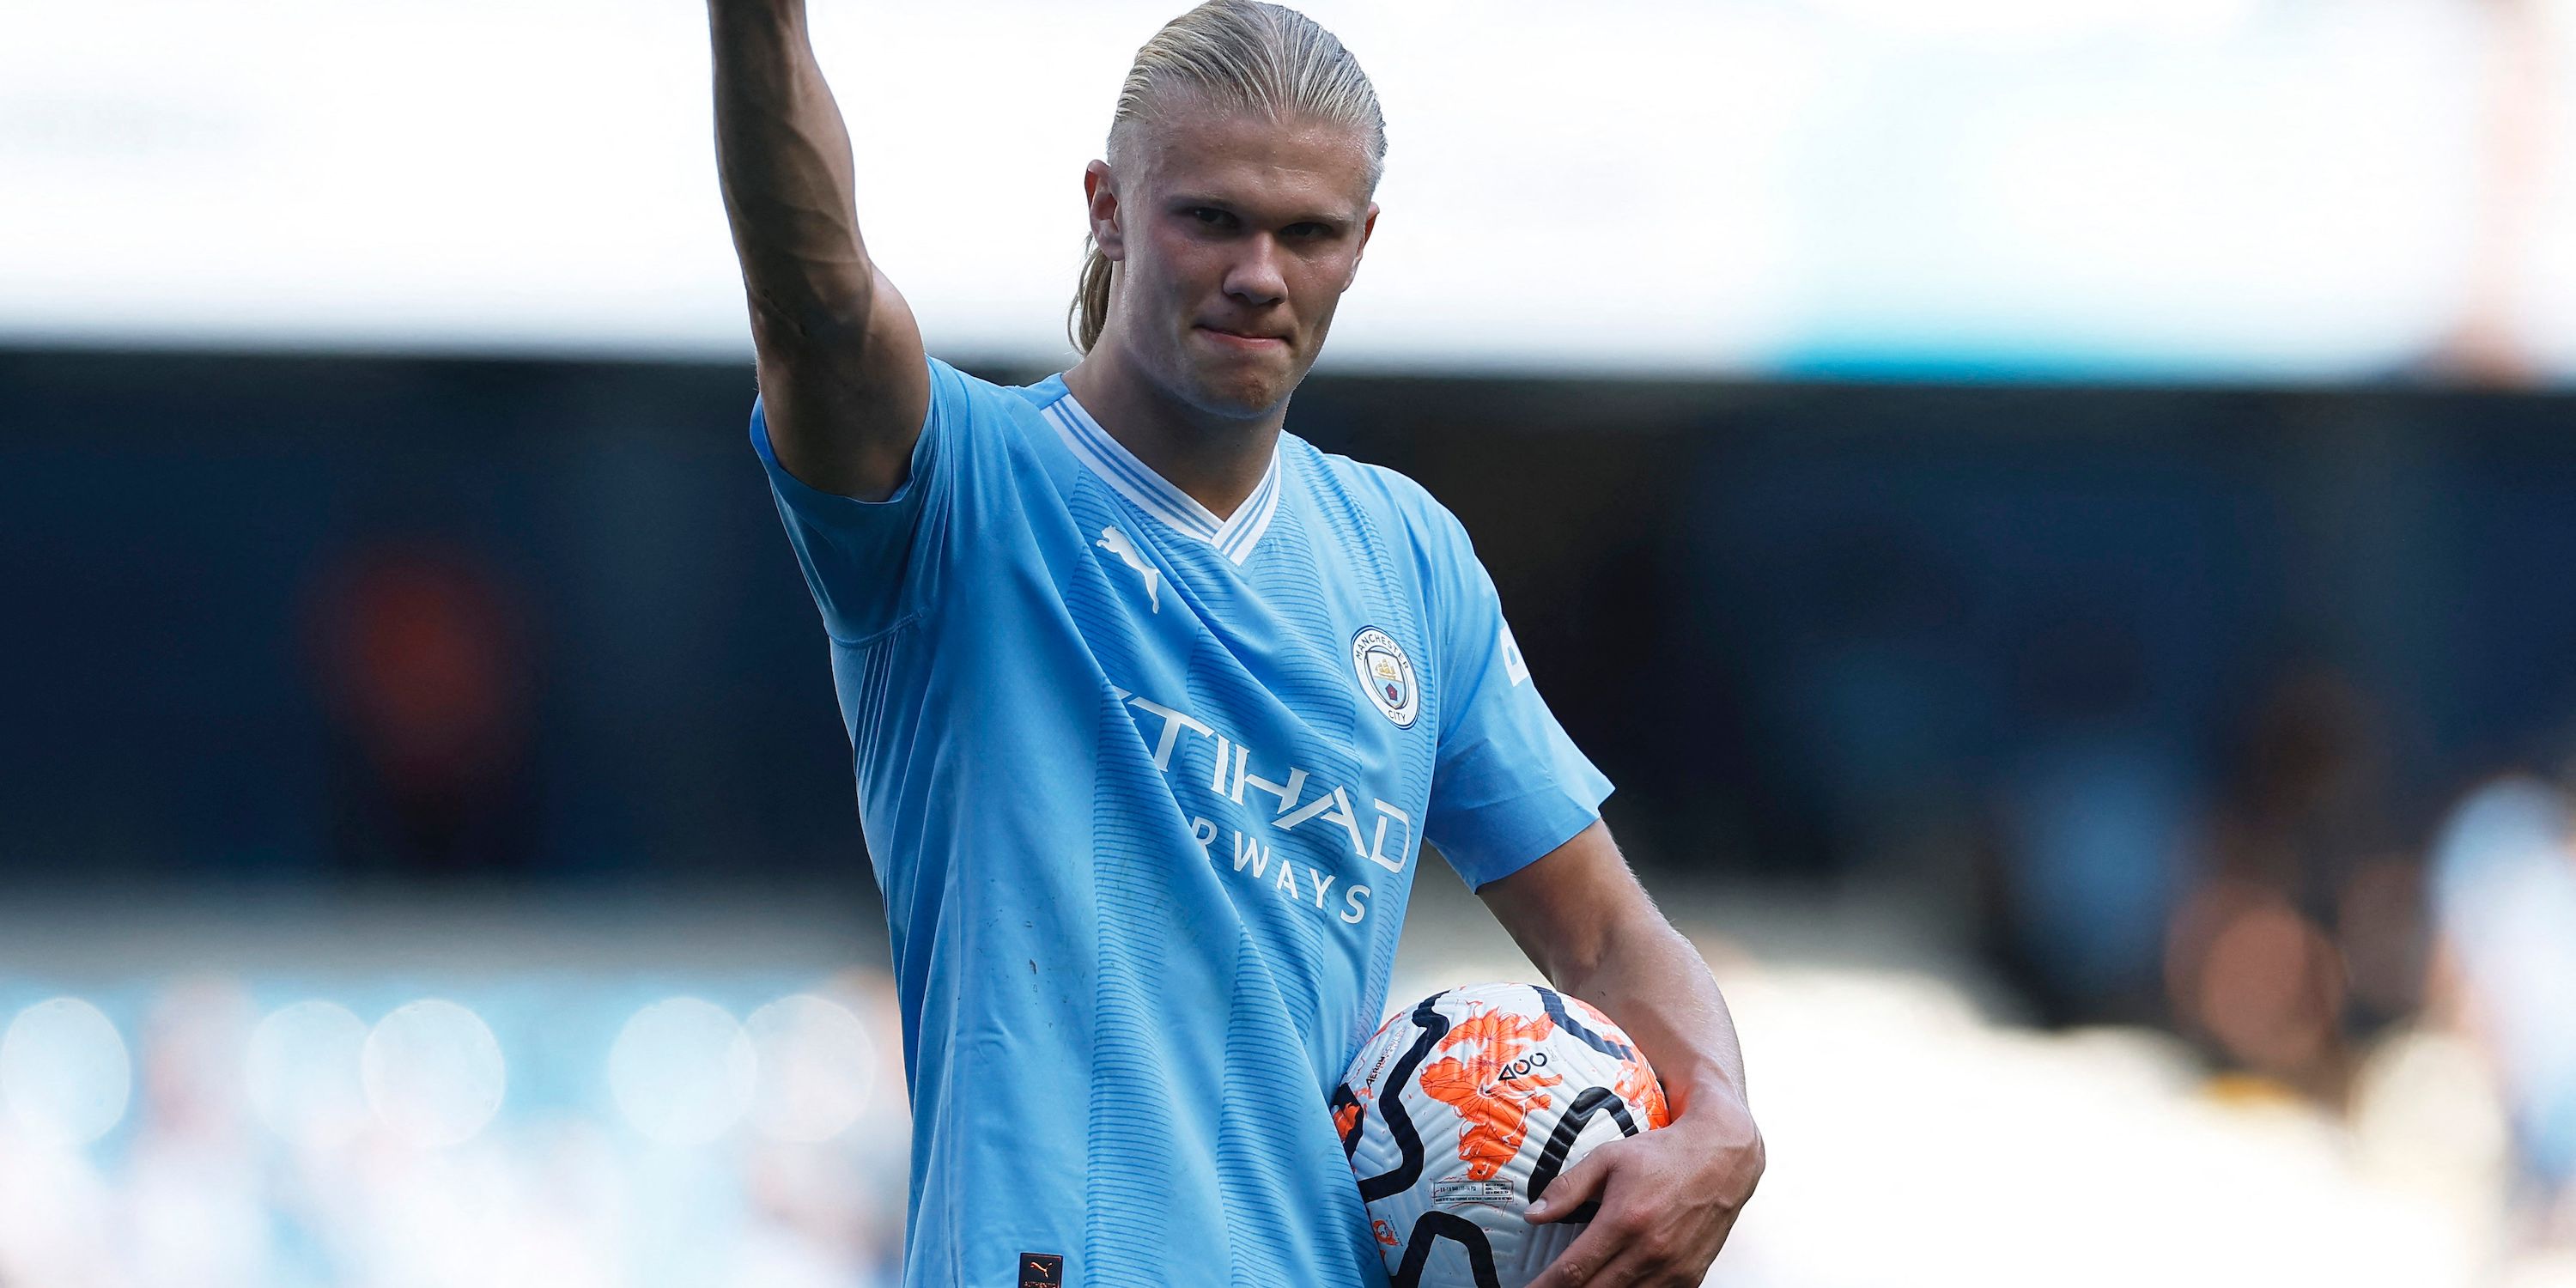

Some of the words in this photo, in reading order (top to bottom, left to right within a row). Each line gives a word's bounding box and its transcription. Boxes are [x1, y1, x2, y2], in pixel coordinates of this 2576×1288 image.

[1356, 633, 1409, 670] MANCHESTER
[1388, 709, 1406, 722] CITY
[1112, 685, 1410, 873] TIHAD
[1192, 816, 1371, 924] RWAYS
